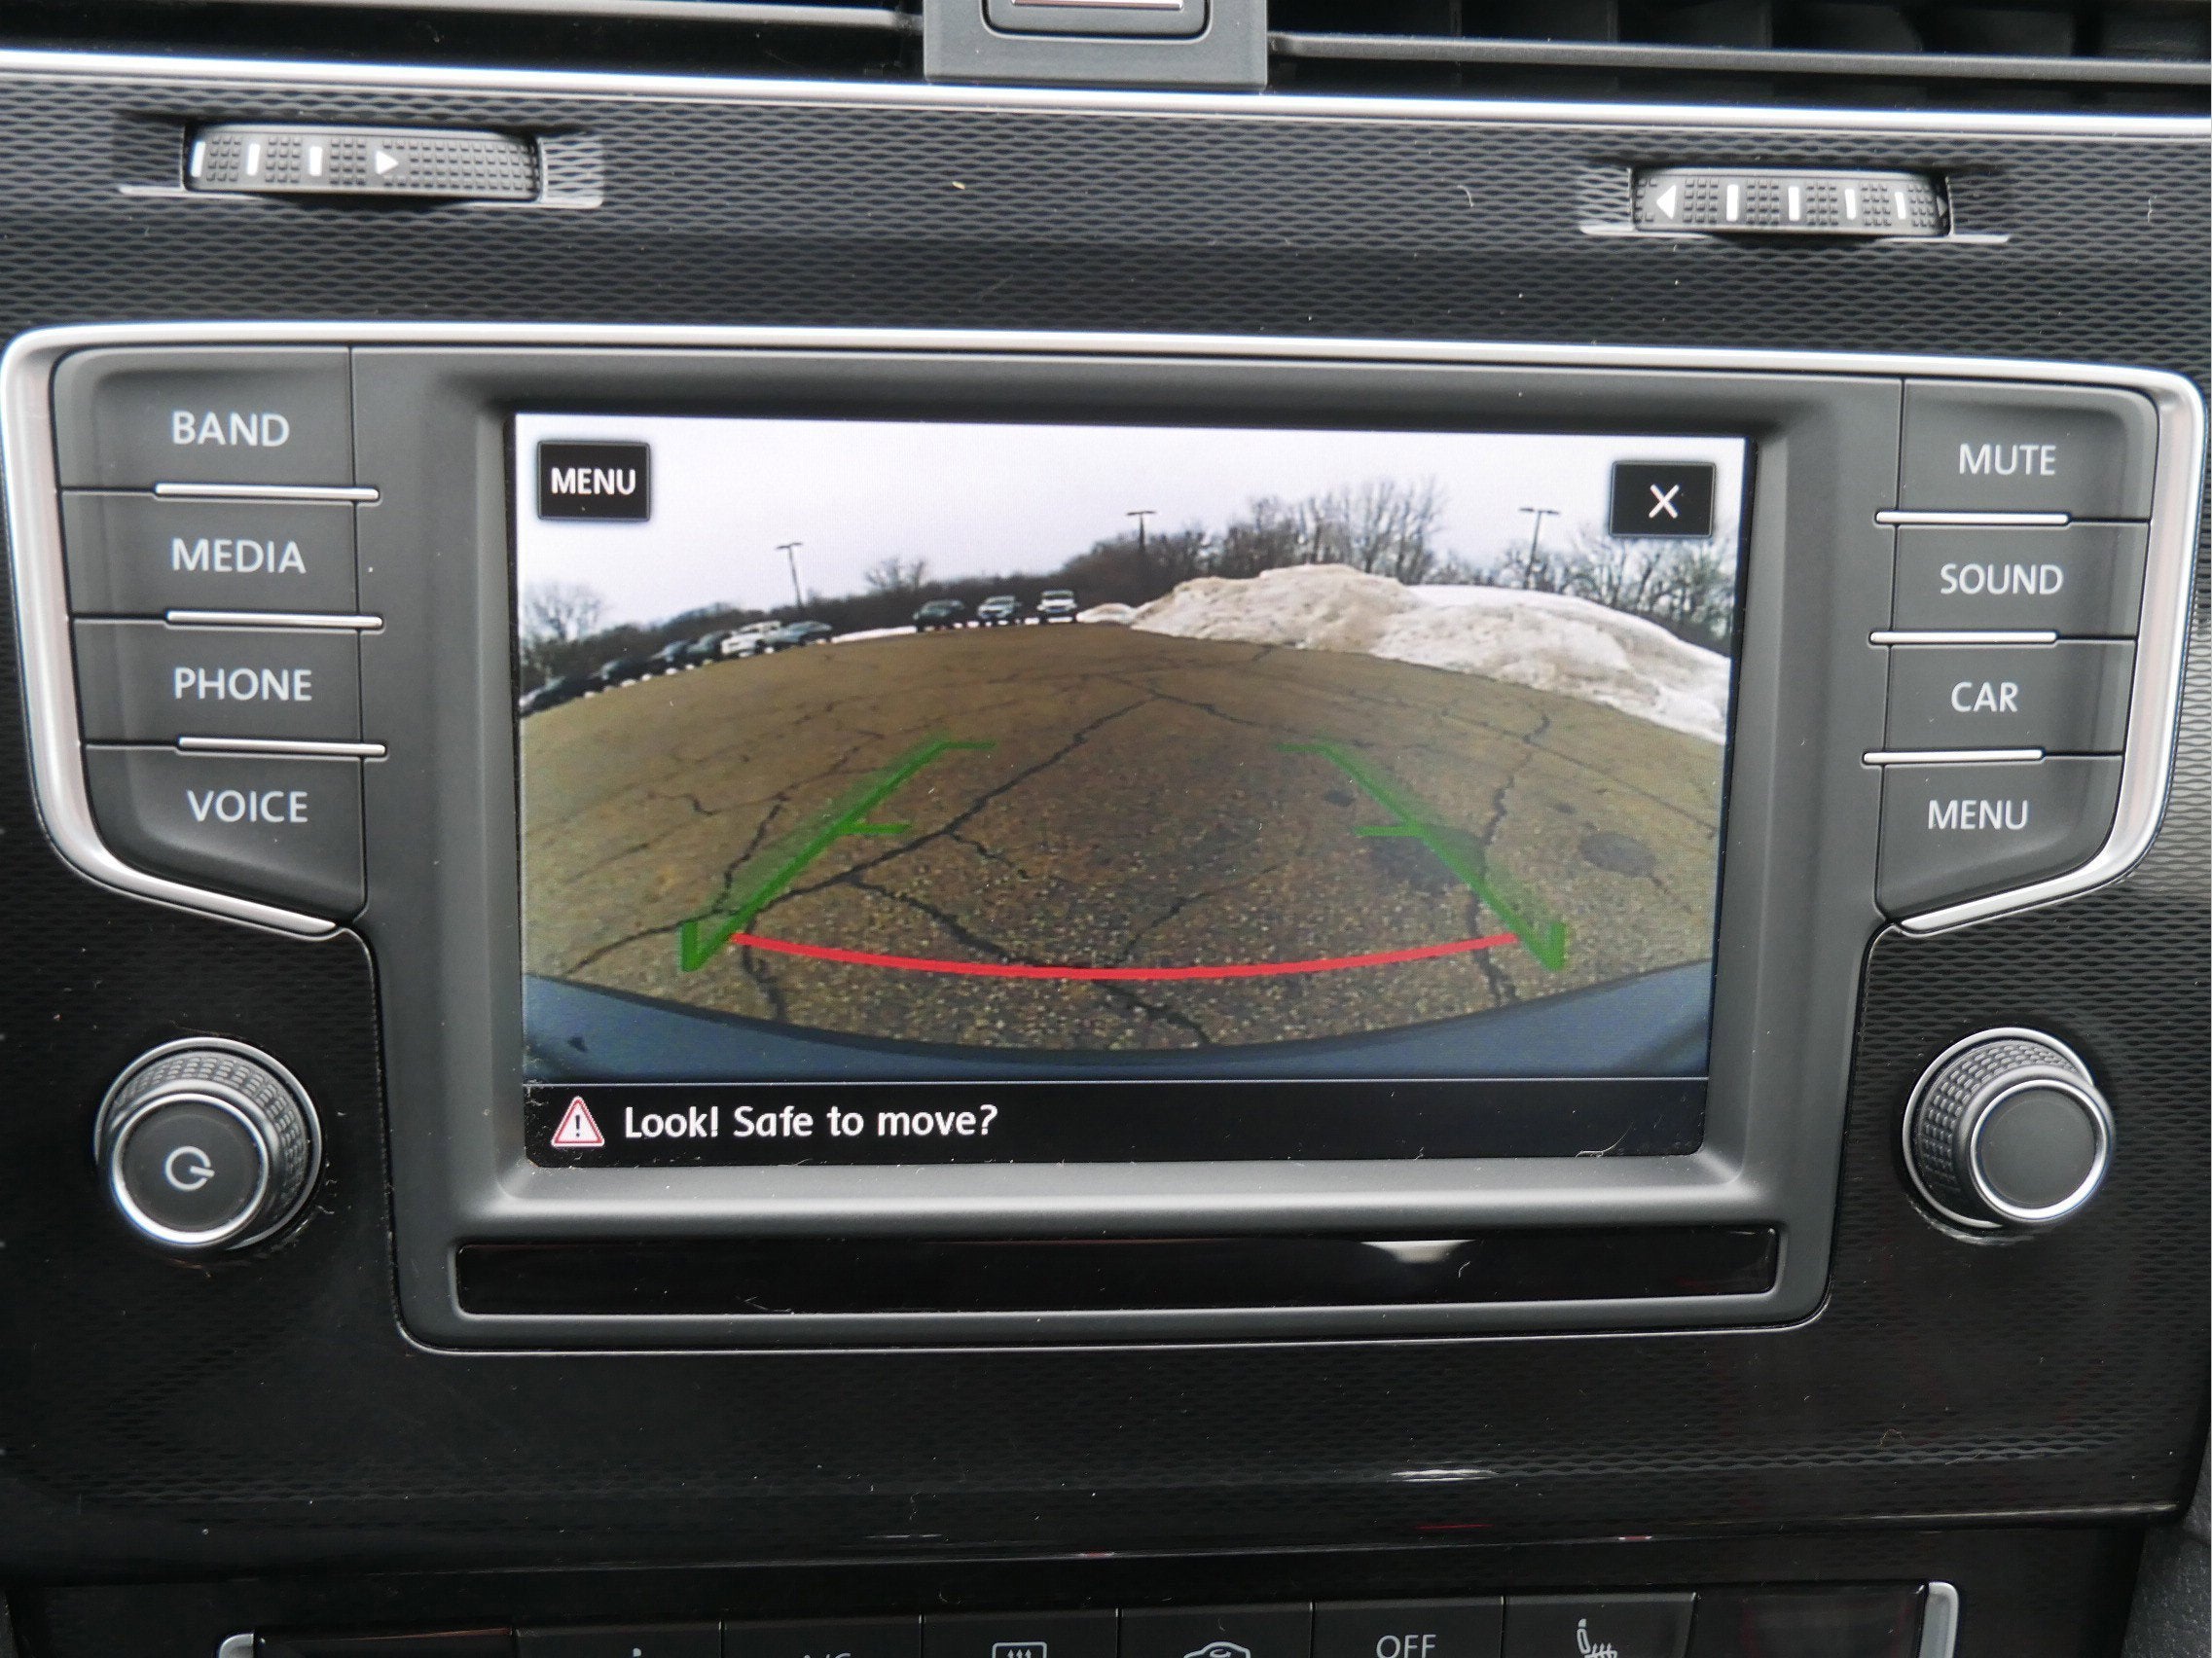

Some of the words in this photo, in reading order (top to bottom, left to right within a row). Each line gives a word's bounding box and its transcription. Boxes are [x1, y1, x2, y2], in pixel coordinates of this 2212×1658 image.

[171, 411, 290, 448] BAND
[1959, 444, 2057, 476] MUTE
[551, 467, 636, 495] MENU
[171, 538, 307, 574] MEDIA
[1940, 563, 2064, 595] SOUND
[174, 667, 312, 702] PHONE
[1950, 681, 2019, 713] CAR
[187, 790, 308, 823] VOICE
[1927, 799, 2029, 831] MENU
[625, 1106, 719, 1138] Look!
[733, 1105, 814, 1138] Safe
[826, 1108, 865, 1137] to
[877, 1102, 998, 1137] move?
[1376, 1634, 1436, 1658] OFF
